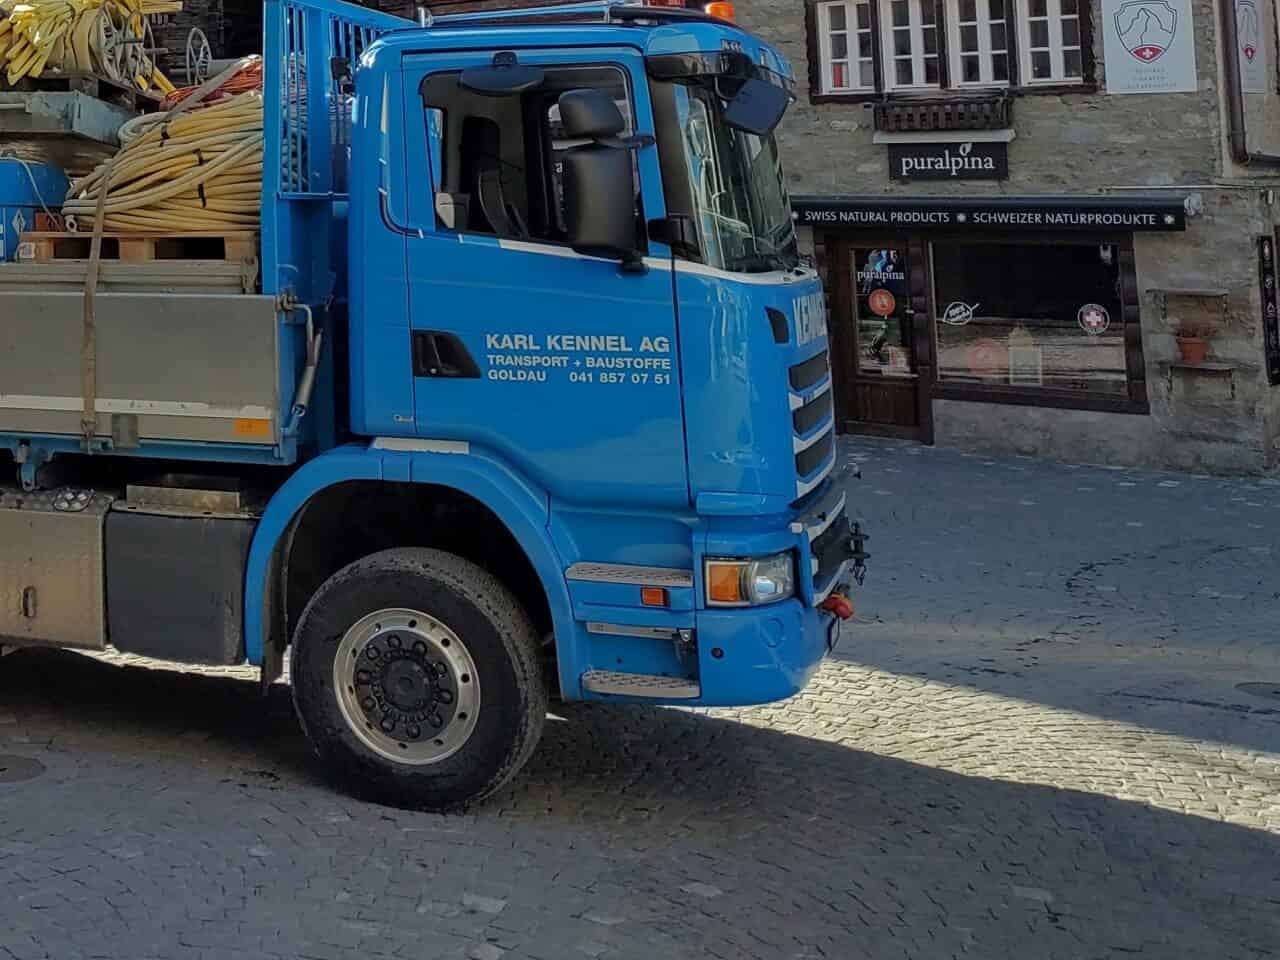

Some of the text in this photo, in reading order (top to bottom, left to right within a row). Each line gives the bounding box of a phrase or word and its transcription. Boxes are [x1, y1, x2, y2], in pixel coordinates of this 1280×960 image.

[901, 144, 996, 175] puralpina
[804, 210, 950, 223] SWISS NATURAL PRODUCTS
[973, 212, 1156, 225] SCHWEIZER NATURPRODUKTE
[857, 267, 905, 283] puralpina
[485, 334, 670, 353] KARL KENNEL AG
[487, 354, 569, 368] TRANSPORT
[586, 357, 670, 369] BAUSTOFFE
[487, 369, 670, 384] GOLDAU 041 857 07 51
